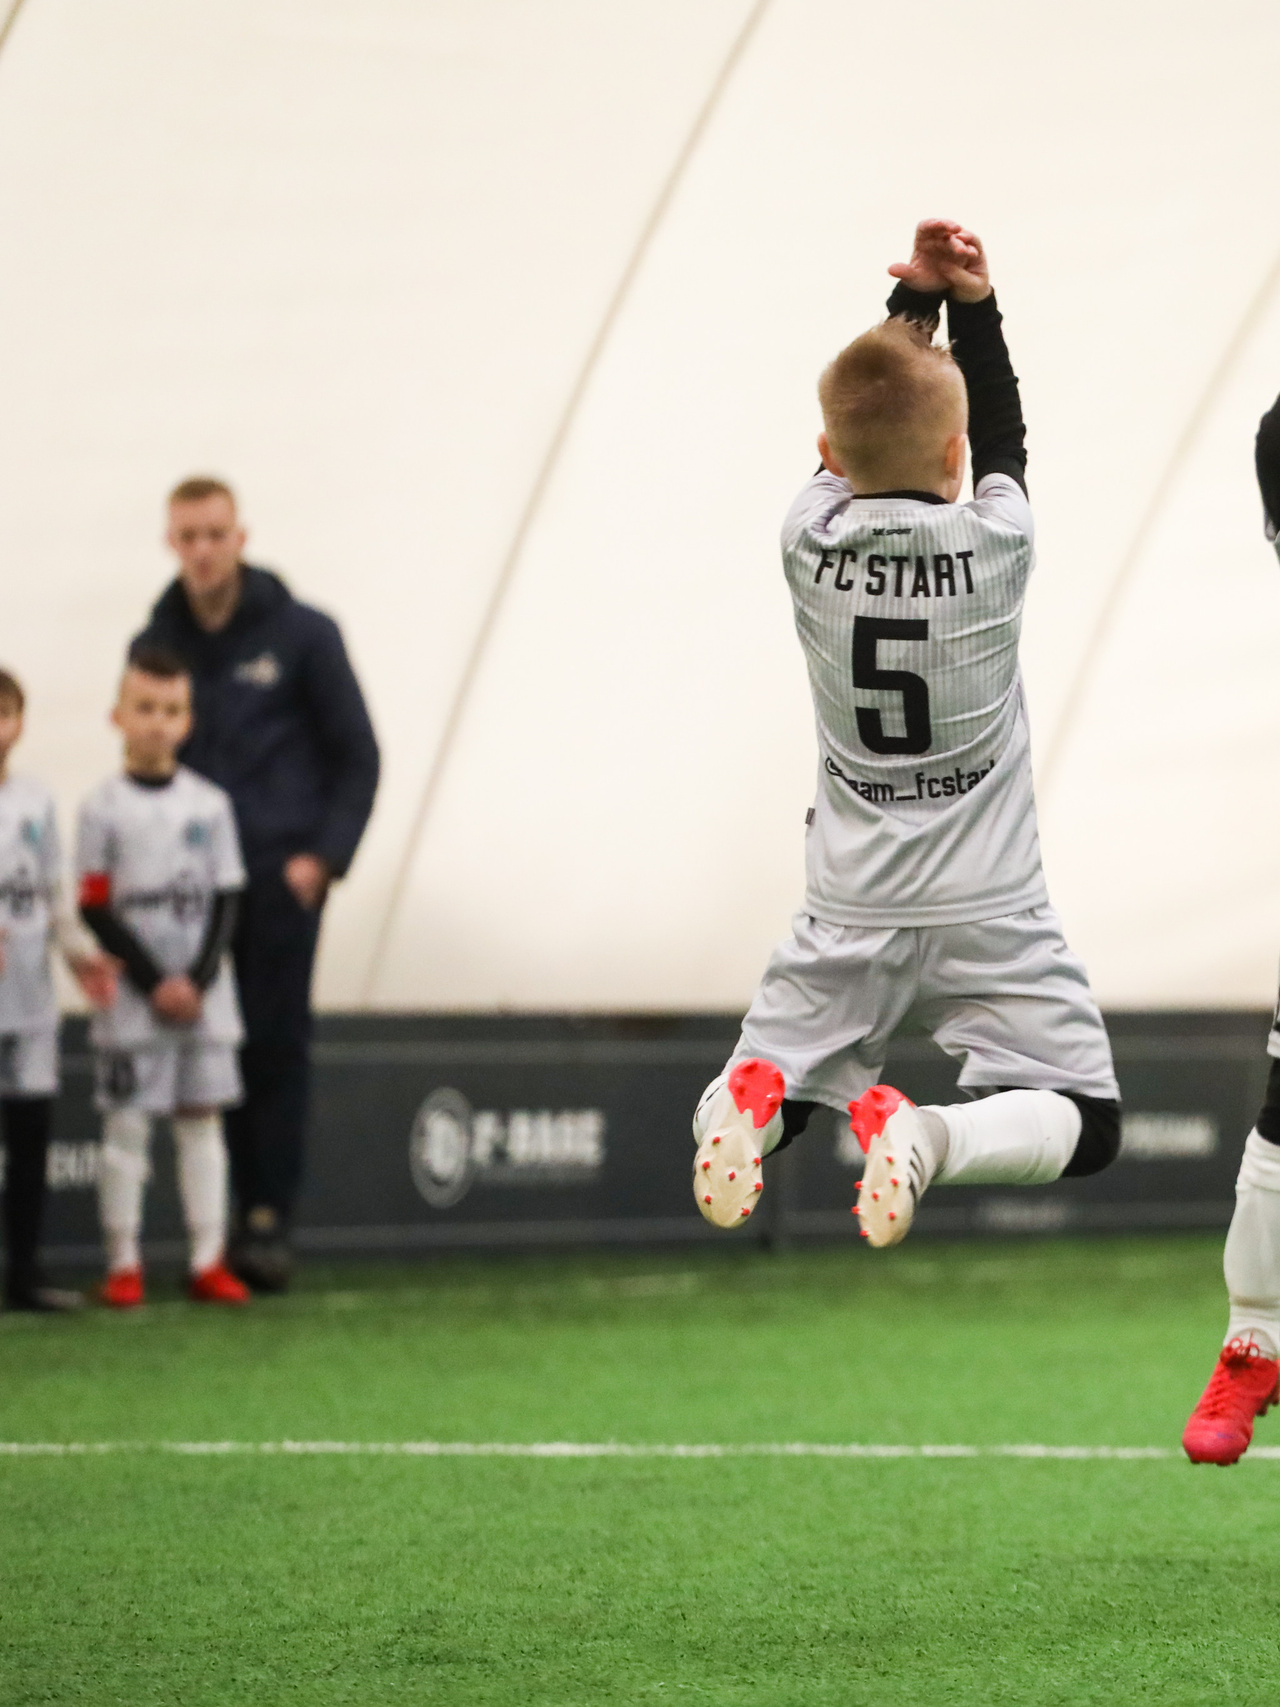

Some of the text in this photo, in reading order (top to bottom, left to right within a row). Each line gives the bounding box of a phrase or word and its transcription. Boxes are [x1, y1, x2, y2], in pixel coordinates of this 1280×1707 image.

[814, 549, 974, 598] FC START
[852, 615, 932, 755] 5
